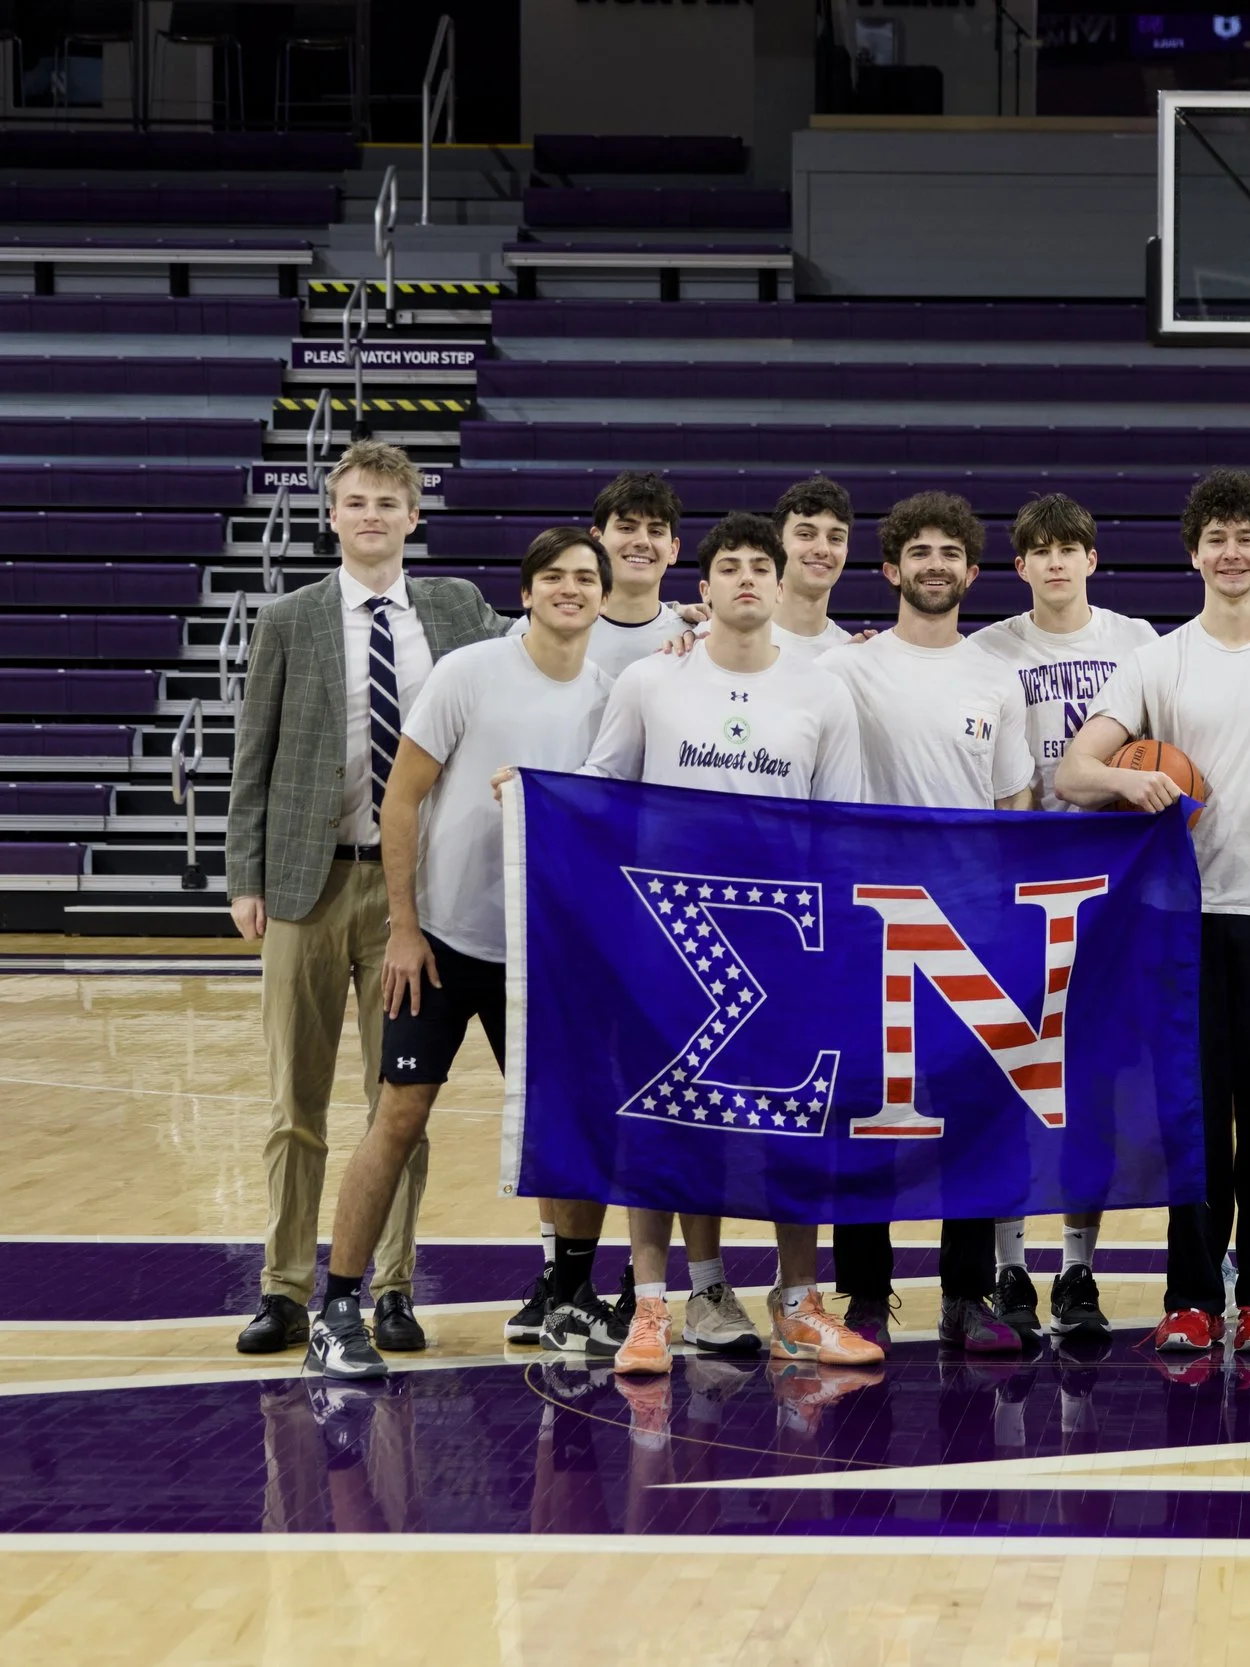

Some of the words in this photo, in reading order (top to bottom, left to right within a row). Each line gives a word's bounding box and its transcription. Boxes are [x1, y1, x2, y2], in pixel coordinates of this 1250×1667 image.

[304, 350, 346, 364] PLEAS
[403, 351, 439, 364] YOUR
[440, 351, 475, 365] STEP
[264, 472, 308, 487] PLEAS
[679, 740, 746, 769] Midwest
[747, 747, 792, 778] Stars
